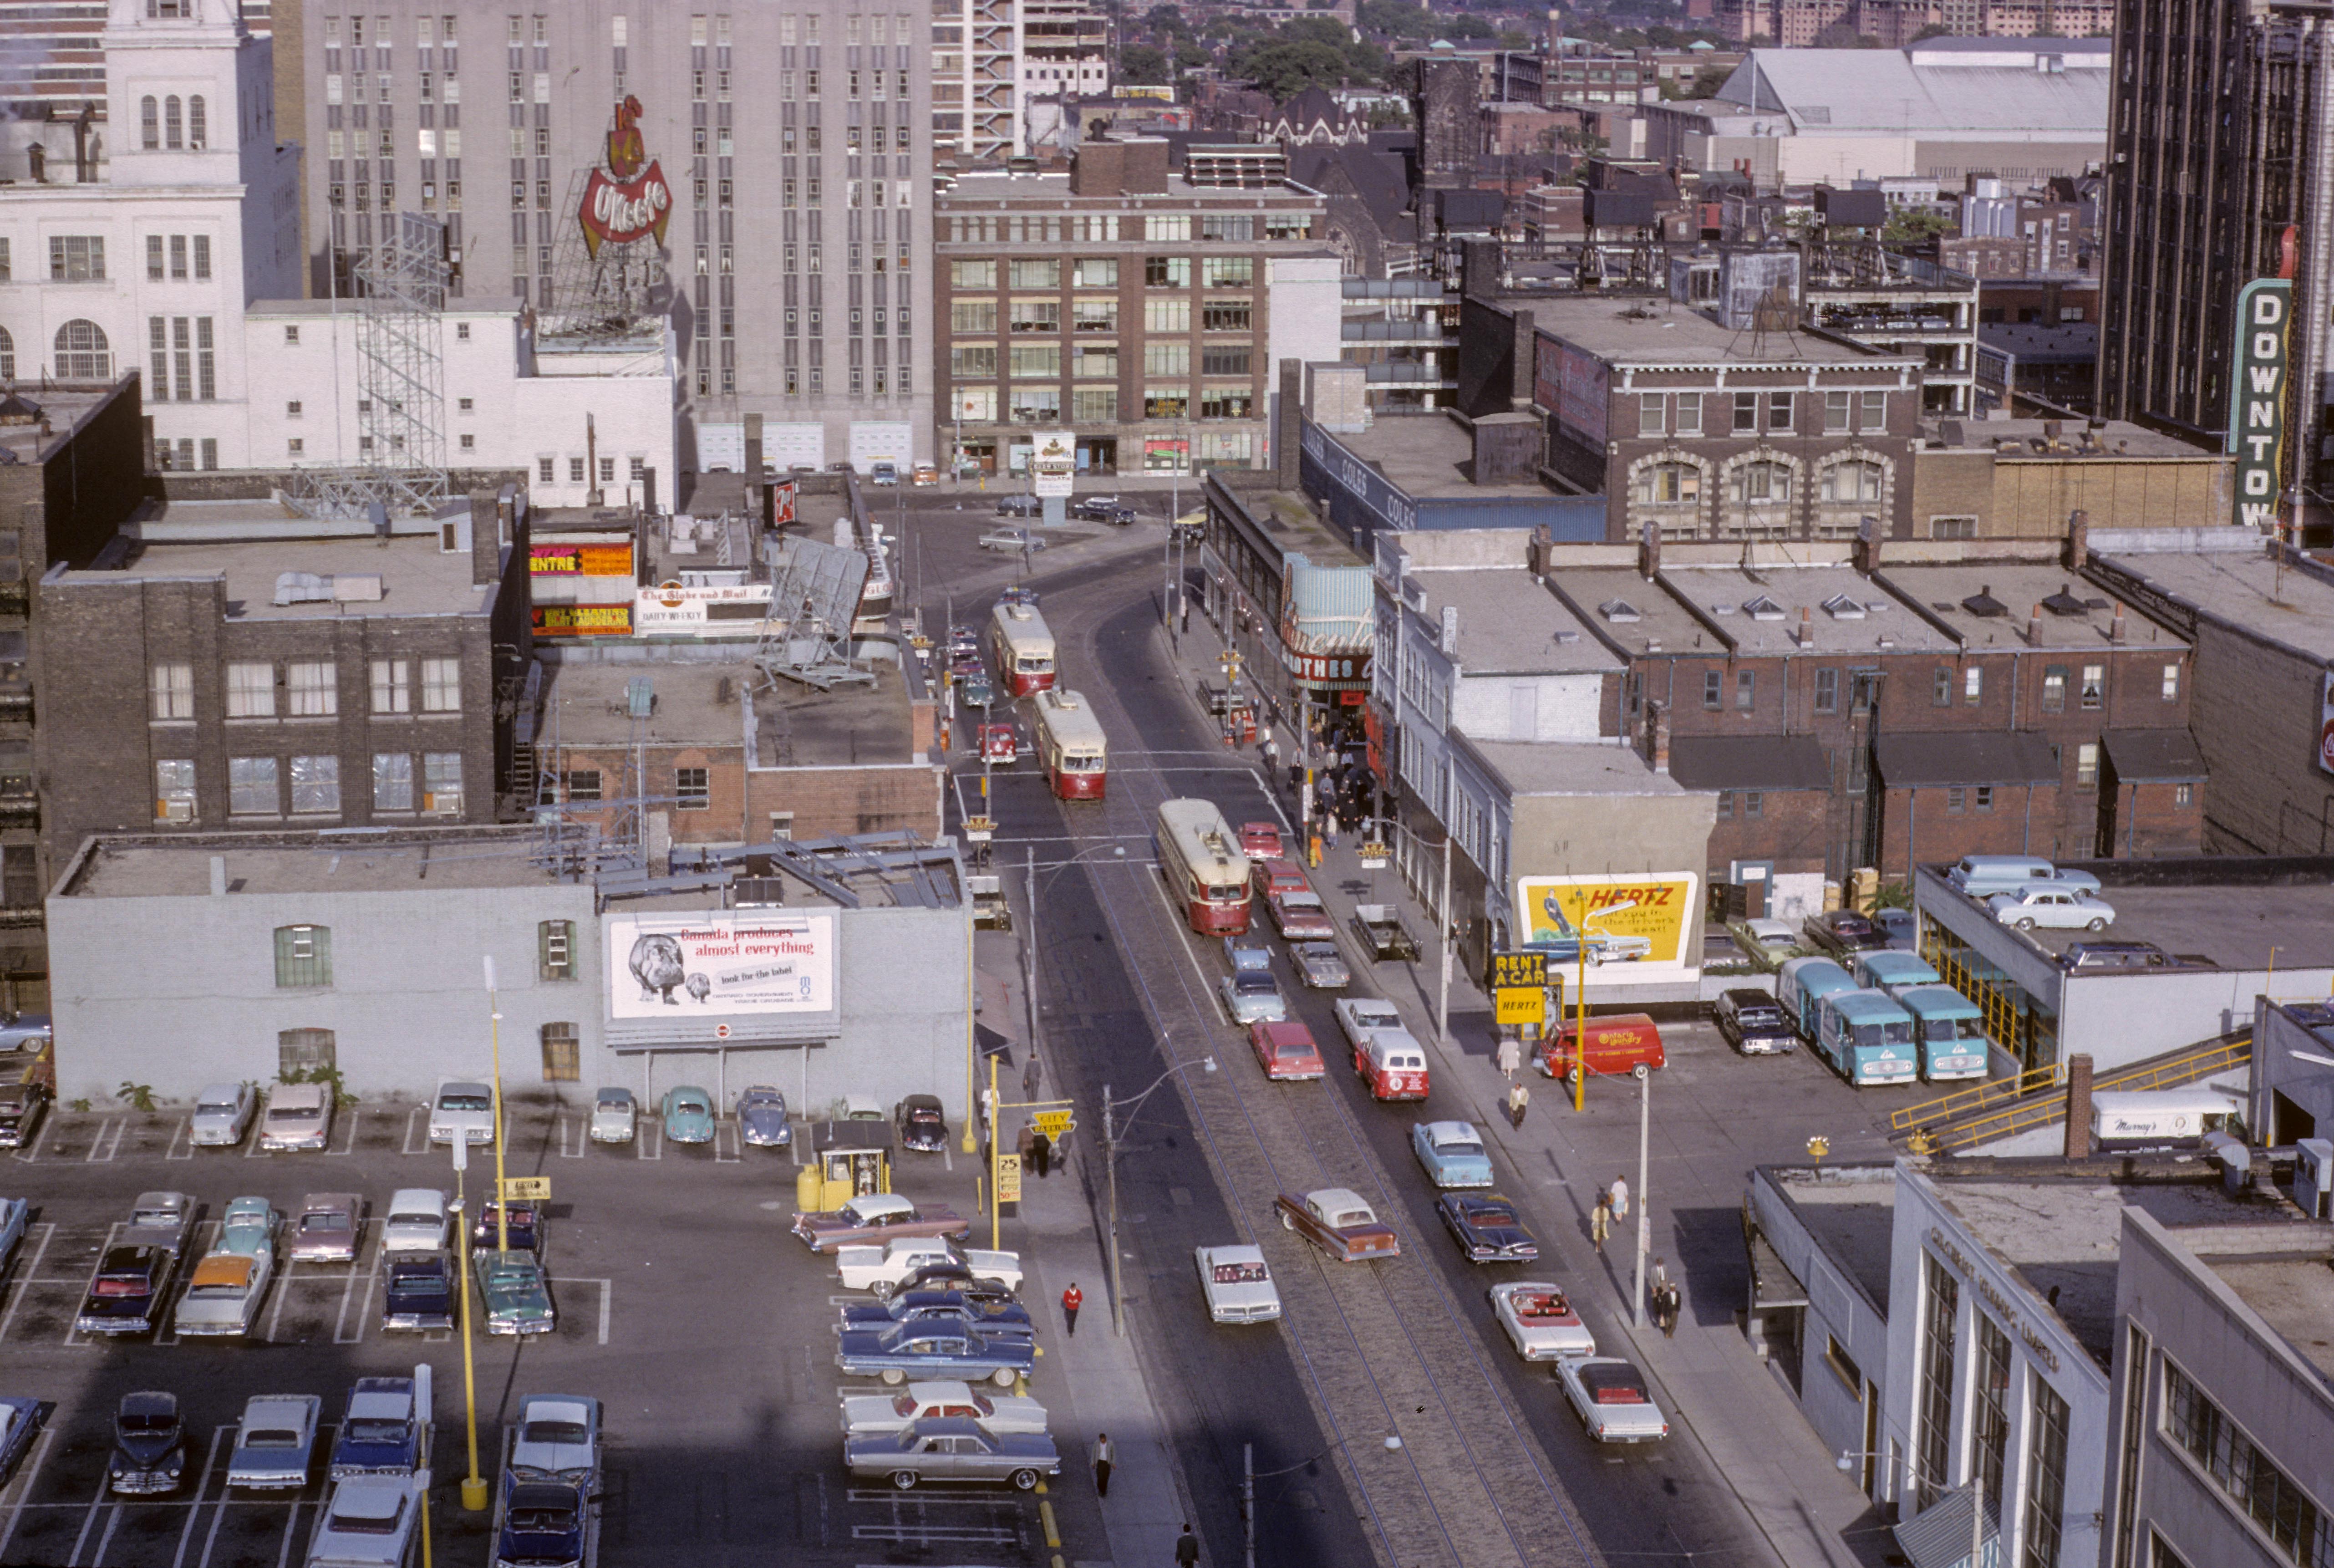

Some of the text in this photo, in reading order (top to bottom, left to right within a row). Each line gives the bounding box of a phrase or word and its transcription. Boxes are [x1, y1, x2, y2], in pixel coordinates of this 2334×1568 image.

[594, 259, 665, 296] ALE
[1342, 458, 1367, 496] COLES
[700, 590, 718, 599] and
[722, 589, 747, 598] Mail
[1589, 887, 1674, 907] HERTZ
[681, 927, 793, 942] Canada produces
[696, 942, 814, 957] almost everything
[1496, 955, 1544, 971] RENT
[721, 966, 792, 984] look for the label
[1495, 970, 1545, 986] A CAR
[1502, 1001, 1538, 1011] HERTZ
[1034, 1124, 1072, 1132] PARKING
[2115, 1119, 2157, 1136] Murray's
[1001, 1159, 1017, 1170] 25
